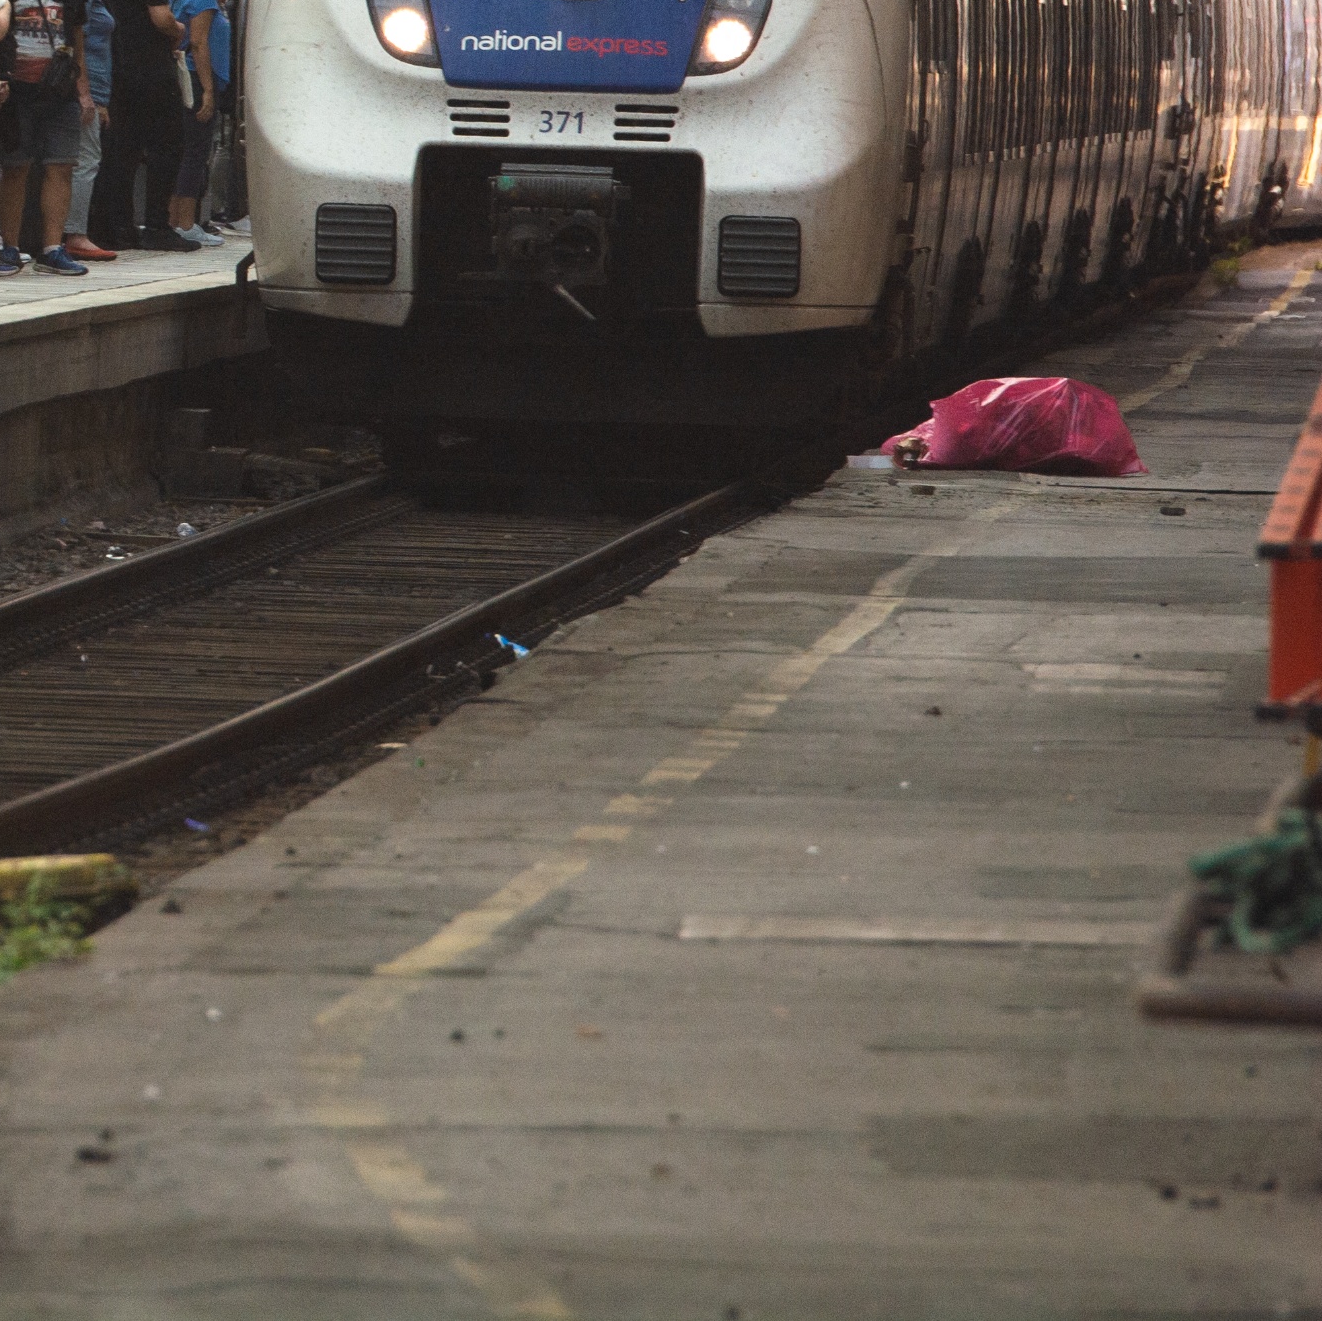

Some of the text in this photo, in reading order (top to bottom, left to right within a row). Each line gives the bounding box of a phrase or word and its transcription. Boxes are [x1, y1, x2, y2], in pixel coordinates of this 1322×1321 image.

[461, 29, 668, 58] national express
[538, 110, 585, 134] 371
